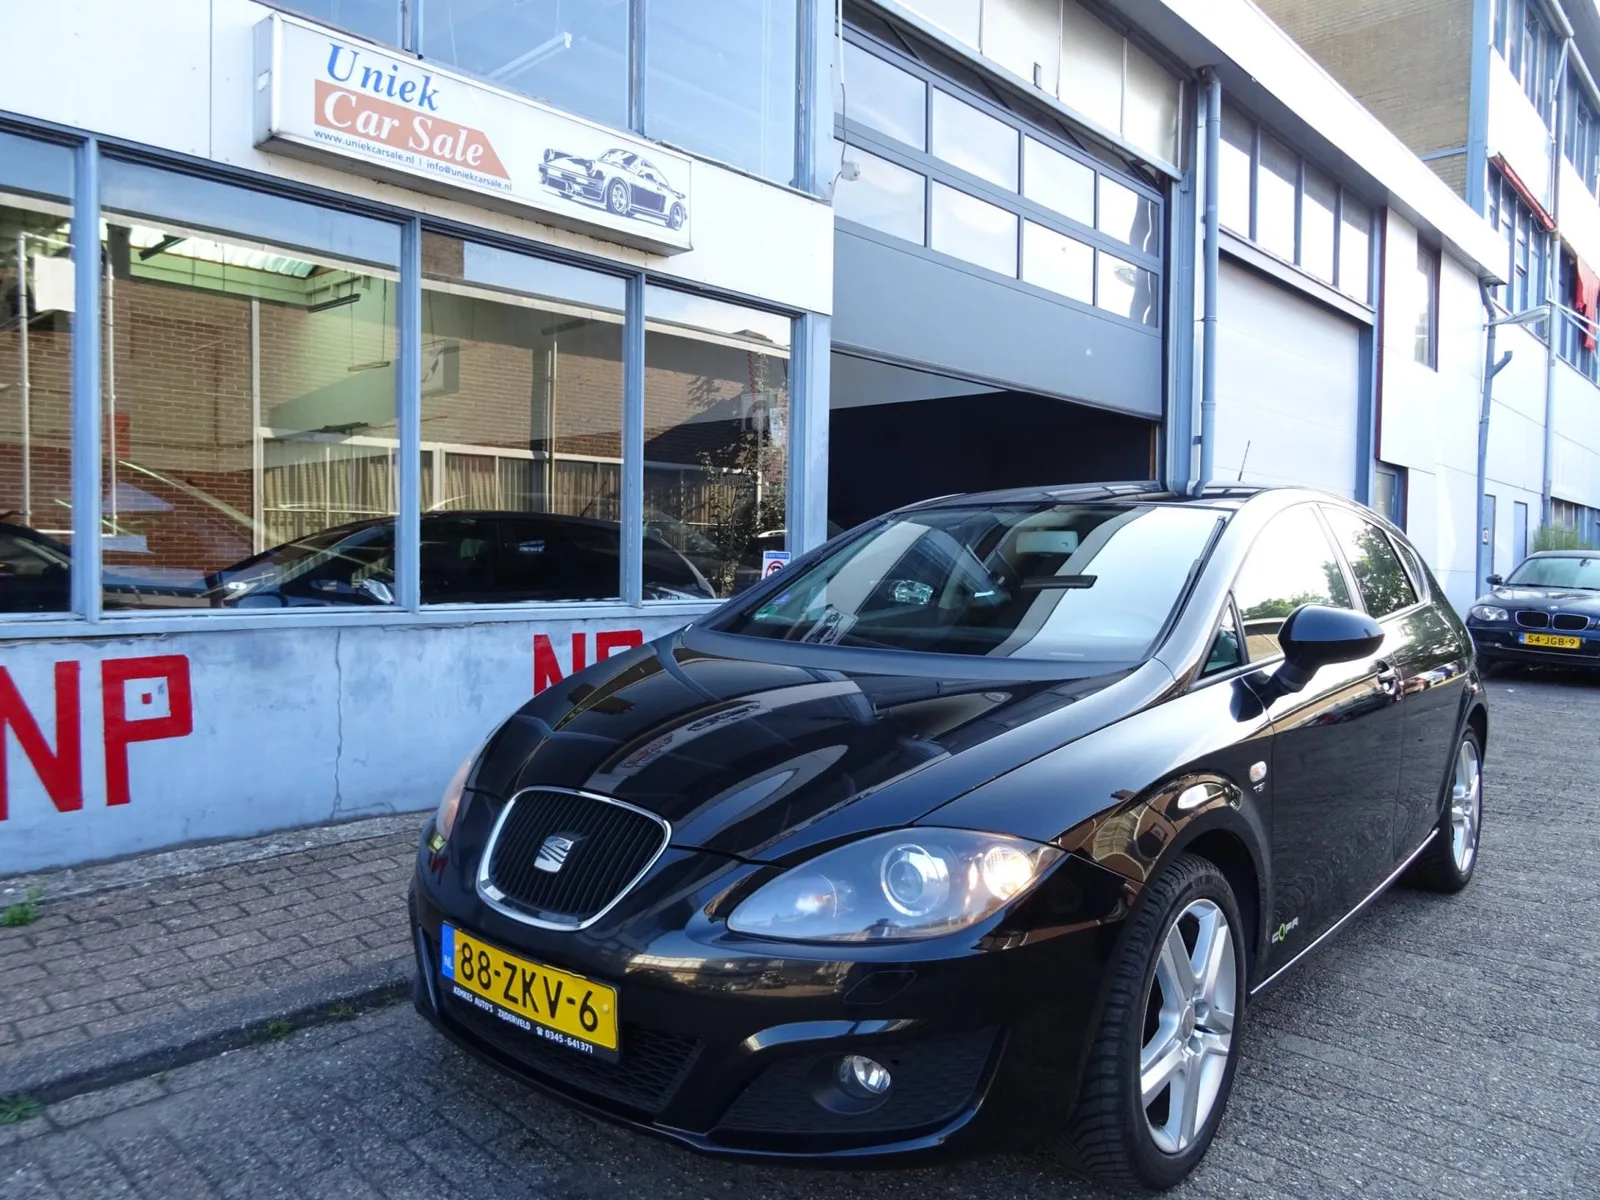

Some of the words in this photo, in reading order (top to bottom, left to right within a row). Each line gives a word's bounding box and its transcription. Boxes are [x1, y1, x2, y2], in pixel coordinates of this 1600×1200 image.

[327, 42, 439, 111] Uniek
[313, 129, 415, 164] www.uniekcarsale.nl
[426, 160, 513, 192] info@uniekcarsale.nl
[323, 90, 400, 140] Car
[408, 115, 484, 167] Sale
[1528, 635, 1576, 647] 54-JGB-9
[0, 654, 194, 822] NP
[460, 941, 599, 1033] 88-ZKV-6
[545, 1029, 594, 1054] 0345-641371
